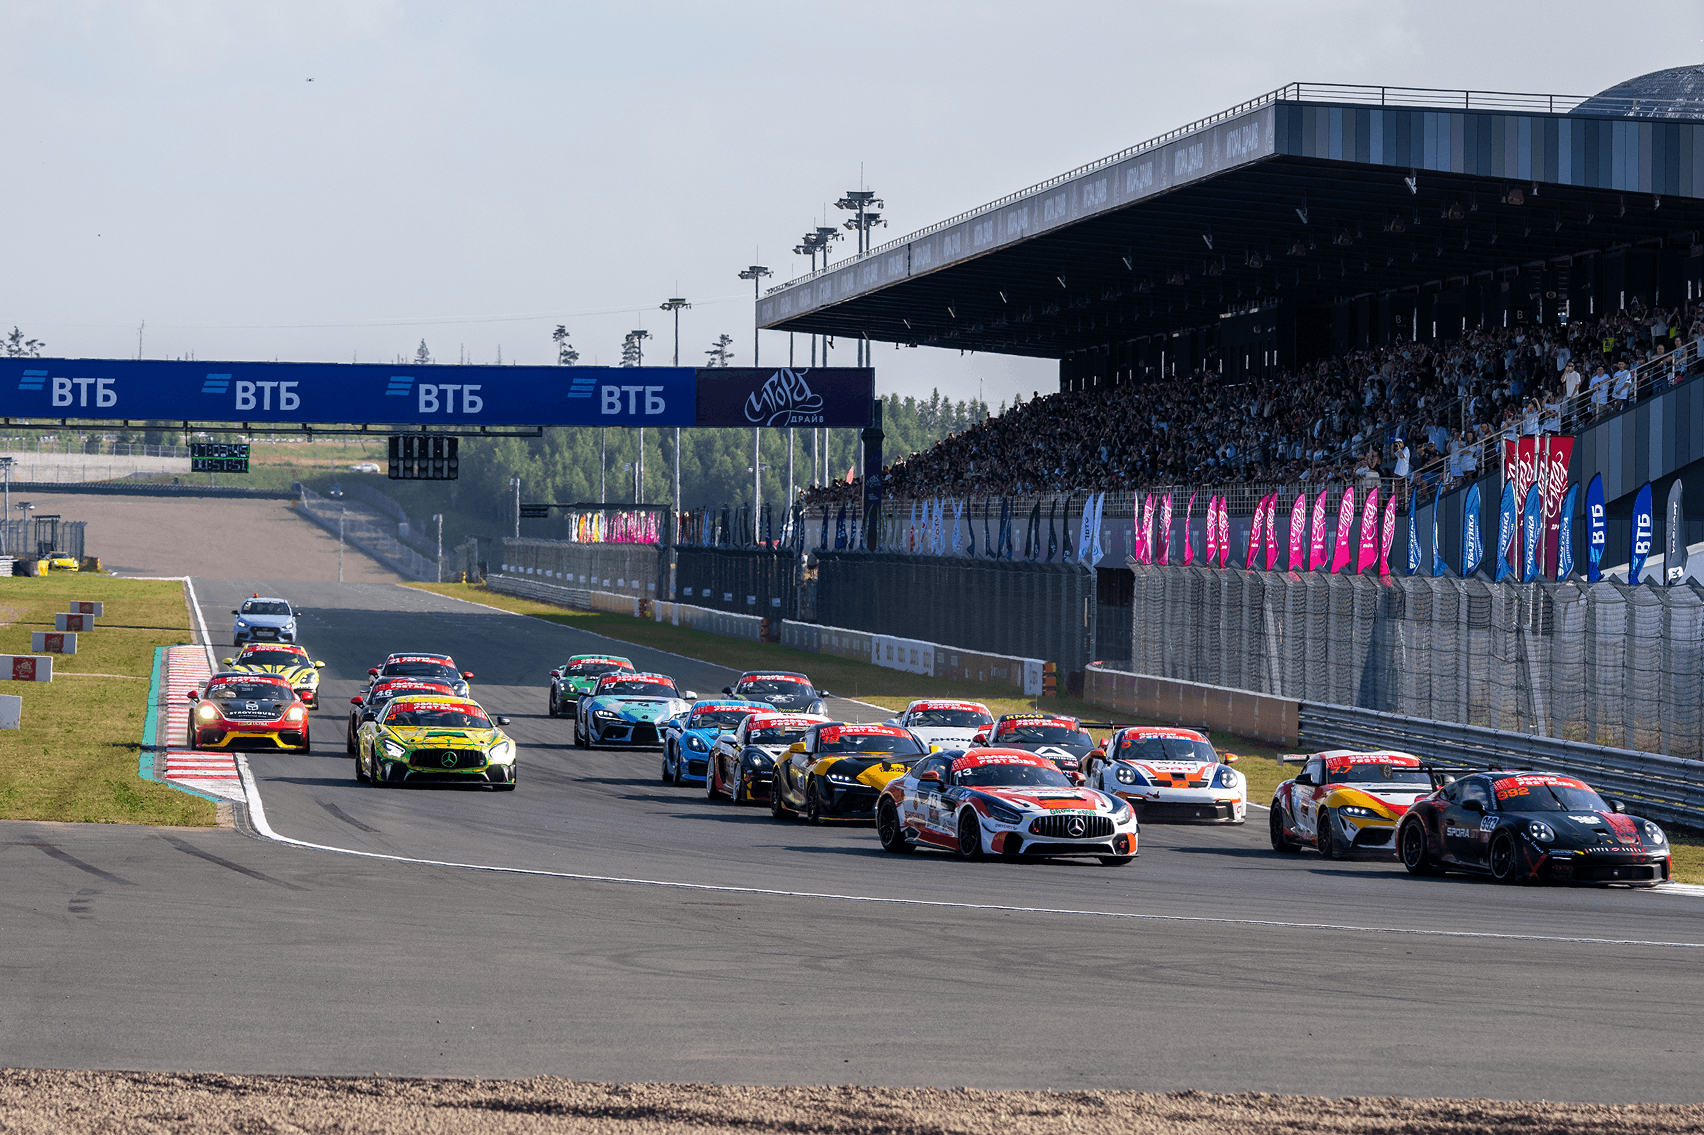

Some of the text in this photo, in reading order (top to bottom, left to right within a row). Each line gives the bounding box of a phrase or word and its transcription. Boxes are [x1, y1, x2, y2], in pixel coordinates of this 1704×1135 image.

[53, 378, 117, 407] ВТБ
[236, 381, 300, 410] ВТБ
[419, 384, 482, 412] ВТБ
[602, 386, 665, 414] ВТБ
[790, 414, 824, 423] ДРАЙВ
[1591, 504, 1605, 544] ВТБ
[1635, 513, 1652, 554] ВТБ
[821, 735, 841, 743] 19
[954, 767, 972, 778] 13
[1330, 765, 1353, 775] 77
[1497, 786, 1530, 800] 992
[1446, 827, 1470, 838] SPORA
